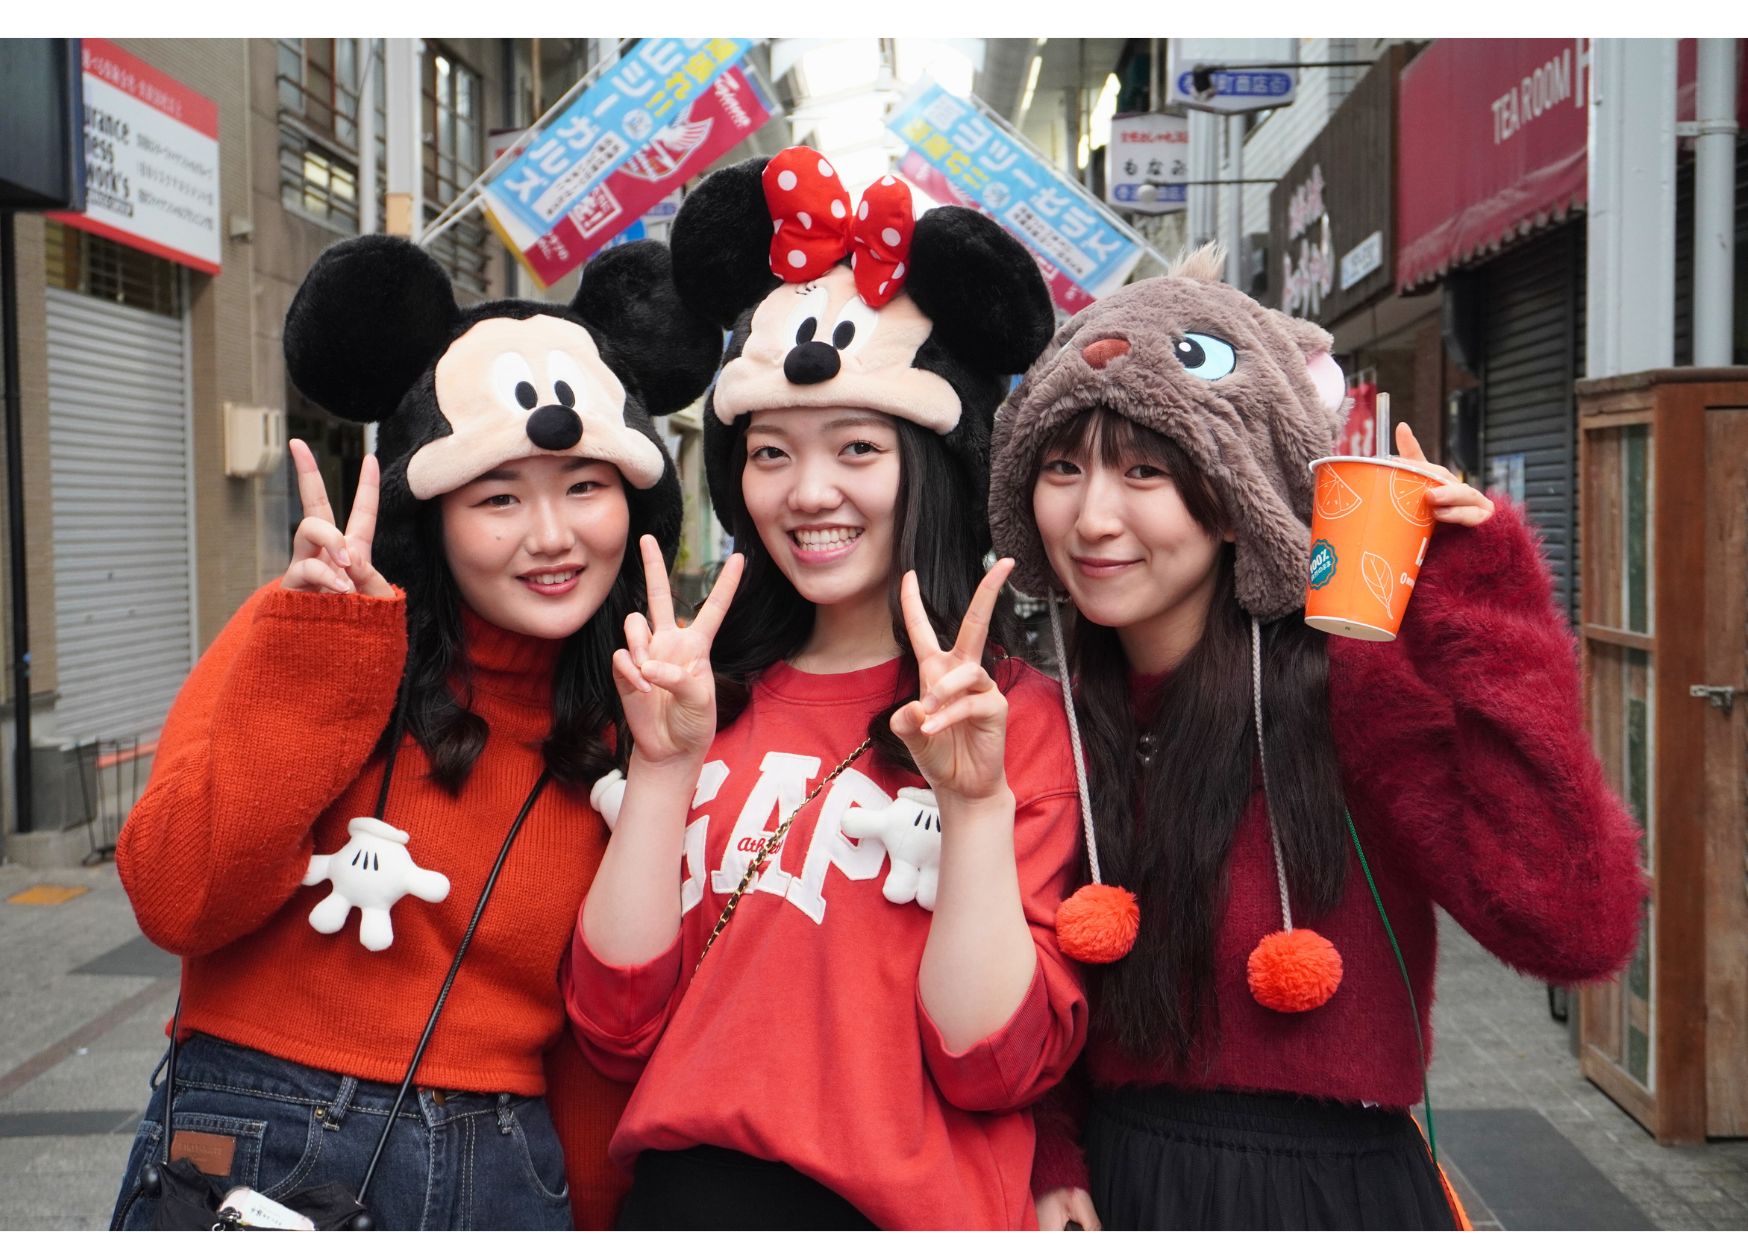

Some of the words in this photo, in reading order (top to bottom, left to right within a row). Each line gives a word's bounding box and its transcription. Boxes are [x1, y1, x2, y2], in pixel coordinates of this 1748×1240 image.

[504, 37, 705, 202] 山シーガルズ
[1491, 86, 1520, 144] TEA
[1522, 49, 1570, 124] ROOM
